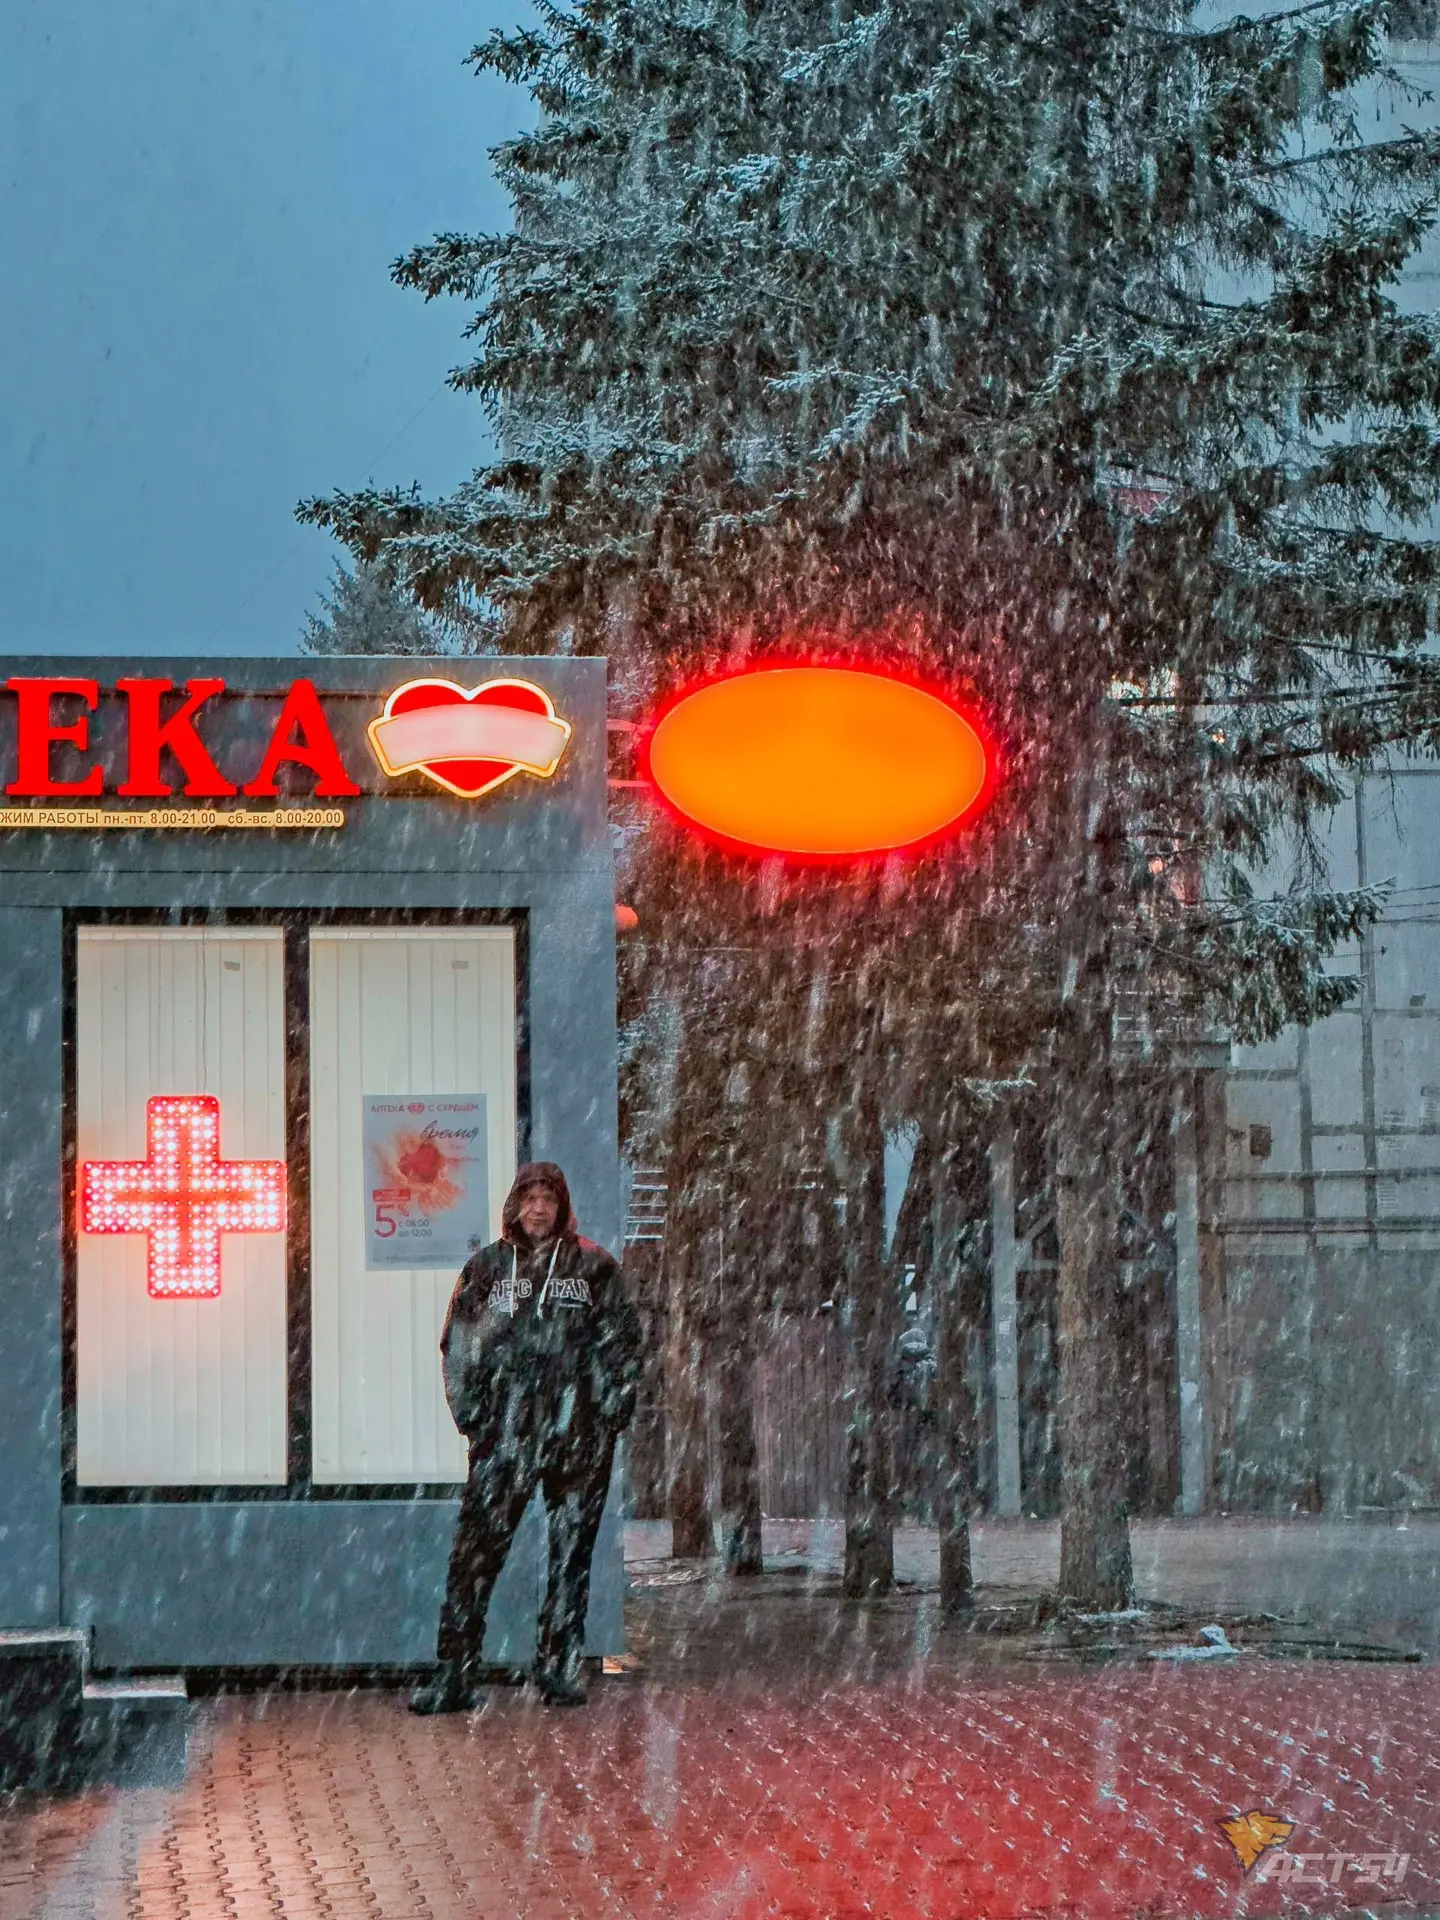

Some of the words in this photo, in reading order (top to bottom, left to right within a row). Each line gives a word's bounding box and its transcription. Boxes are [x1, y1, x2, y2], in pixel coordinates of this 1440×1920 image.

[6, 678, 361, 796] ЕКА
[0, 812, 34, 824] ЖИМ
[39, 812, 99, 824] РАБОТЫ
[150, 812, 216, 824] 8.00-21.00
[275, 812, 341, 824] 8.00-20.00
[371, 1104, 405, 1113] АПТЕКА
[411, 1228, 433, 1237] 12:00
